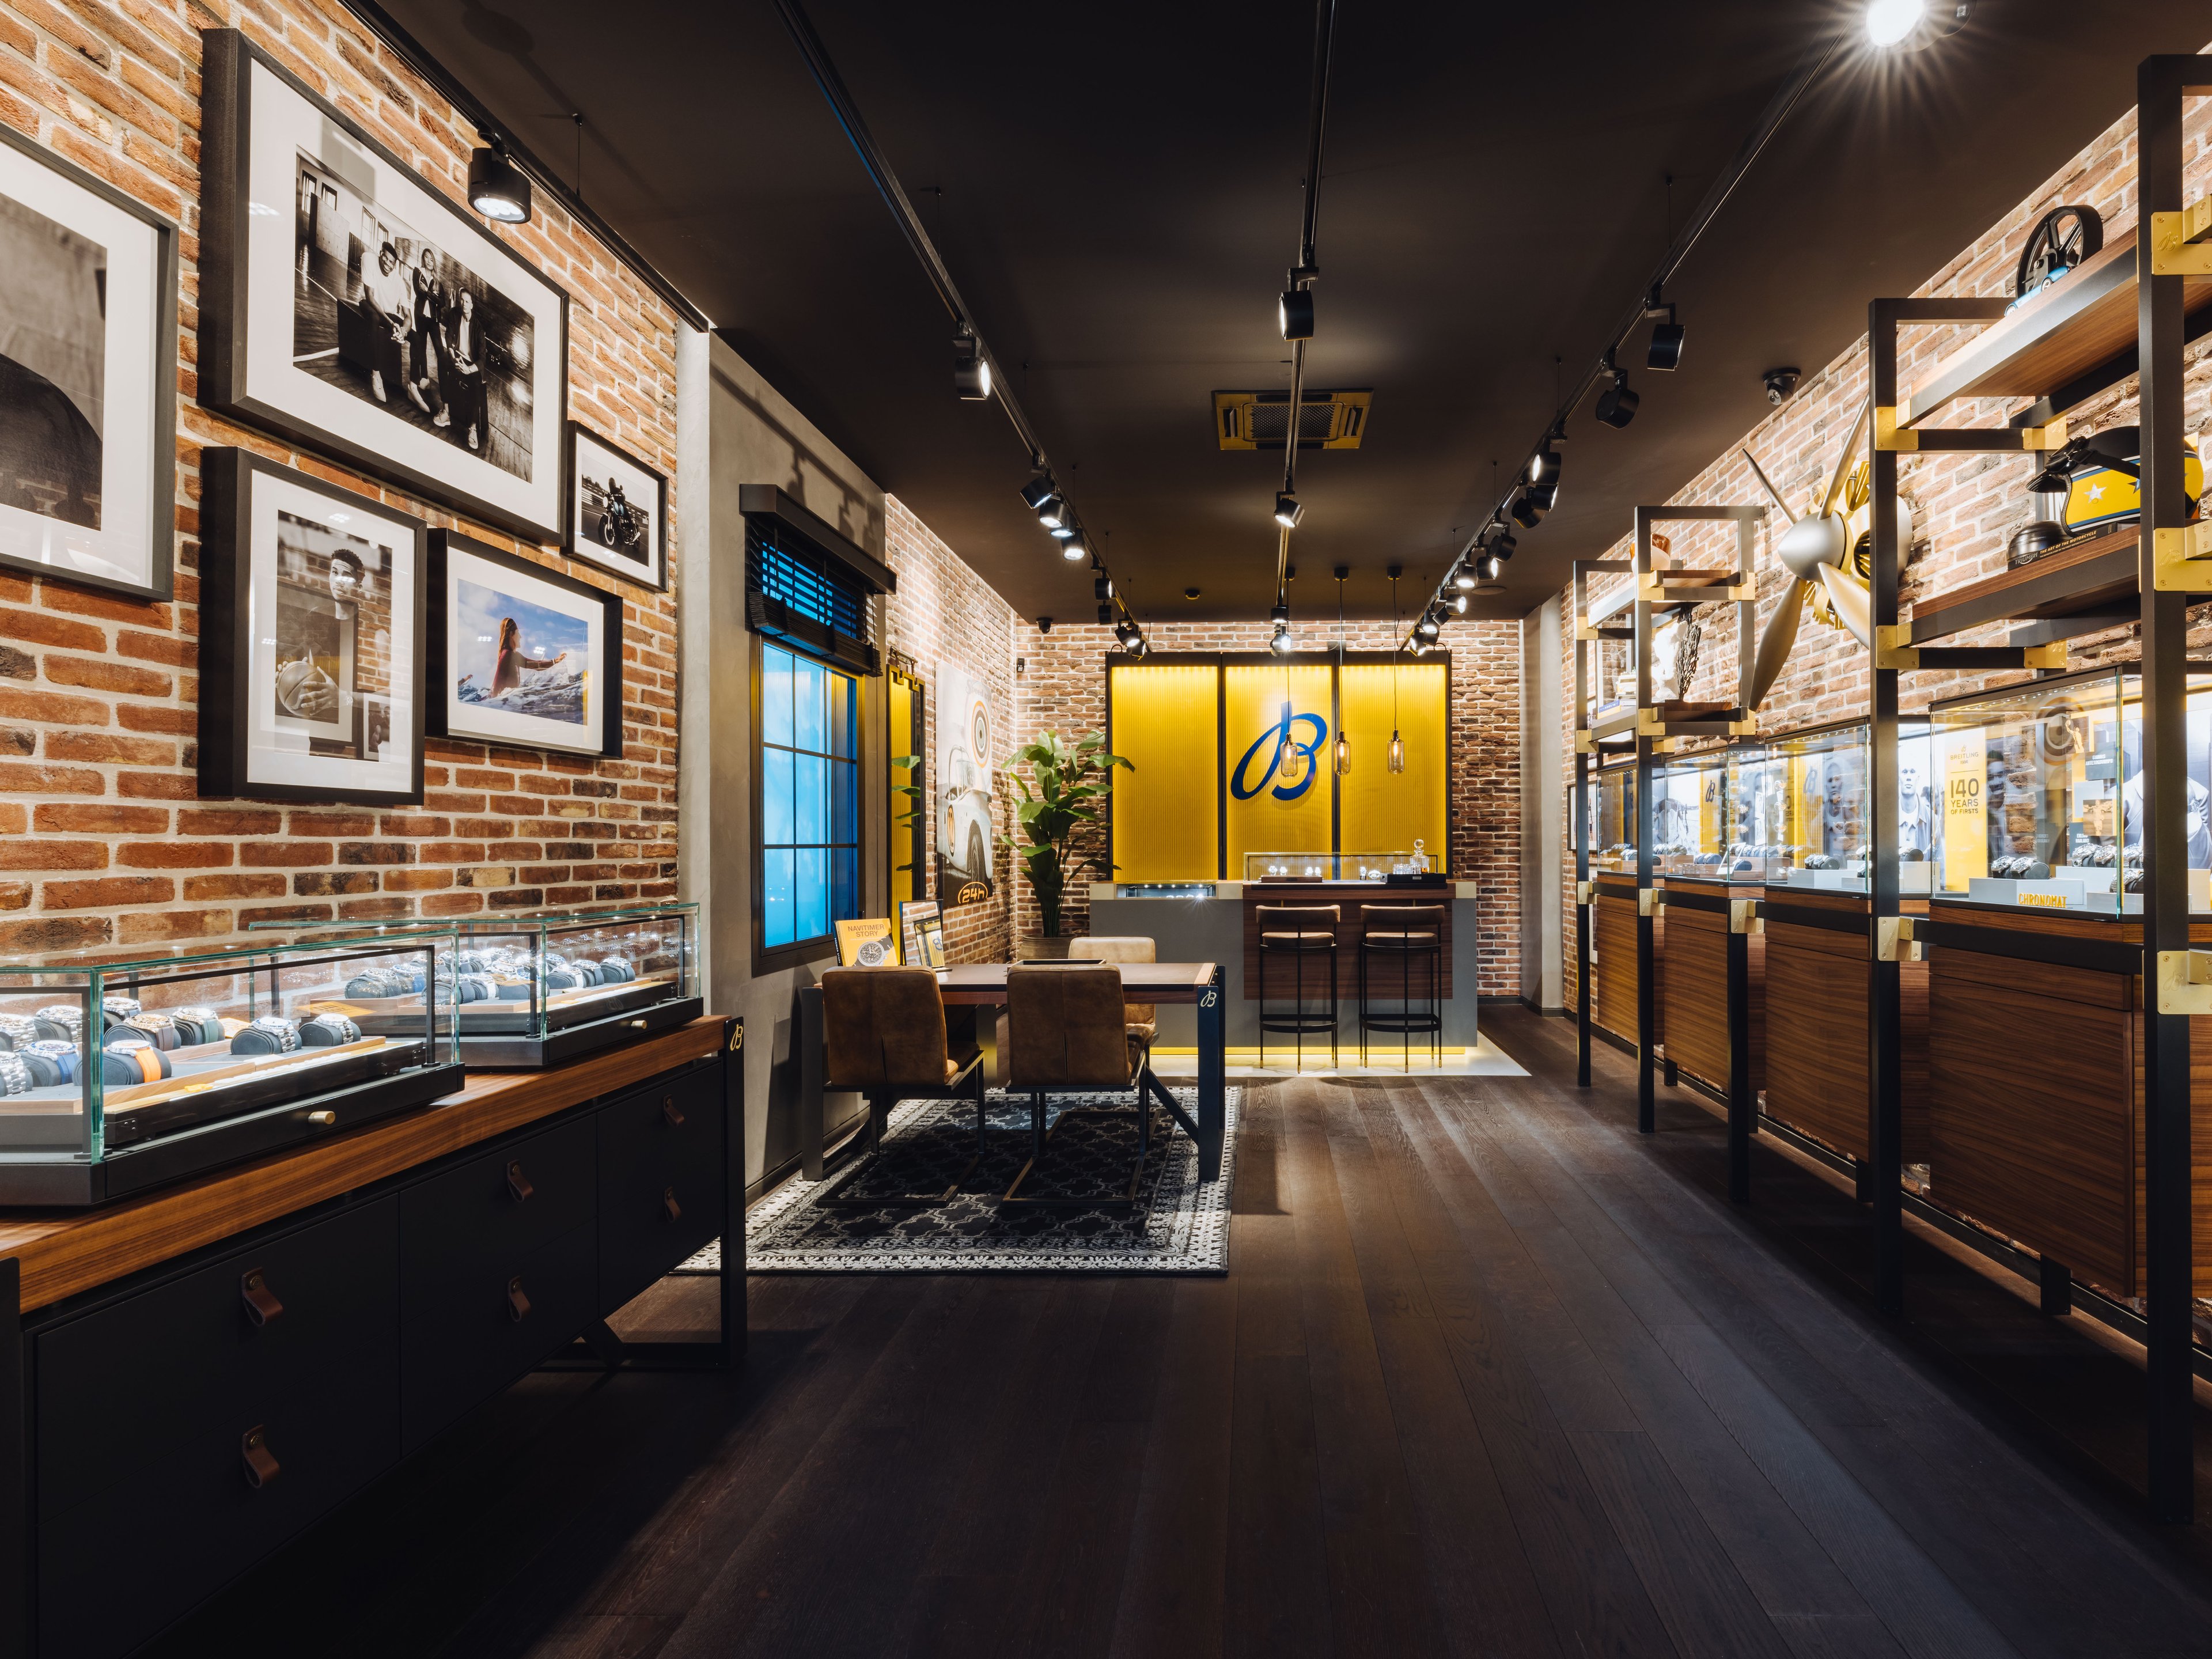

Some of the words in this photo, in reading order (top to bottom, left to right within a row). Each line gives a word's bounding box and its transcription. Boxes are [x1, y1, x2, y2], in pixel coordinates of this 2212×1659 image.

[2070, 531, 2097, 543] MOTORCYCLE
[2015, 552, 2038, 565] TRIUMPH
[1230, 701, 1327, 801] B
[1950, 752, 1979, 760] BREITLING
[1950, 778, 1979, 798] 140
[1950, 798, 1979, 808] YEARS
[962, 888, 985, 903] 24h
[2018, 892, 2068, 908] CHRONOMAT
[1200, 990, 1217, 1007] B
[730, 1024, 744, 1051] B
